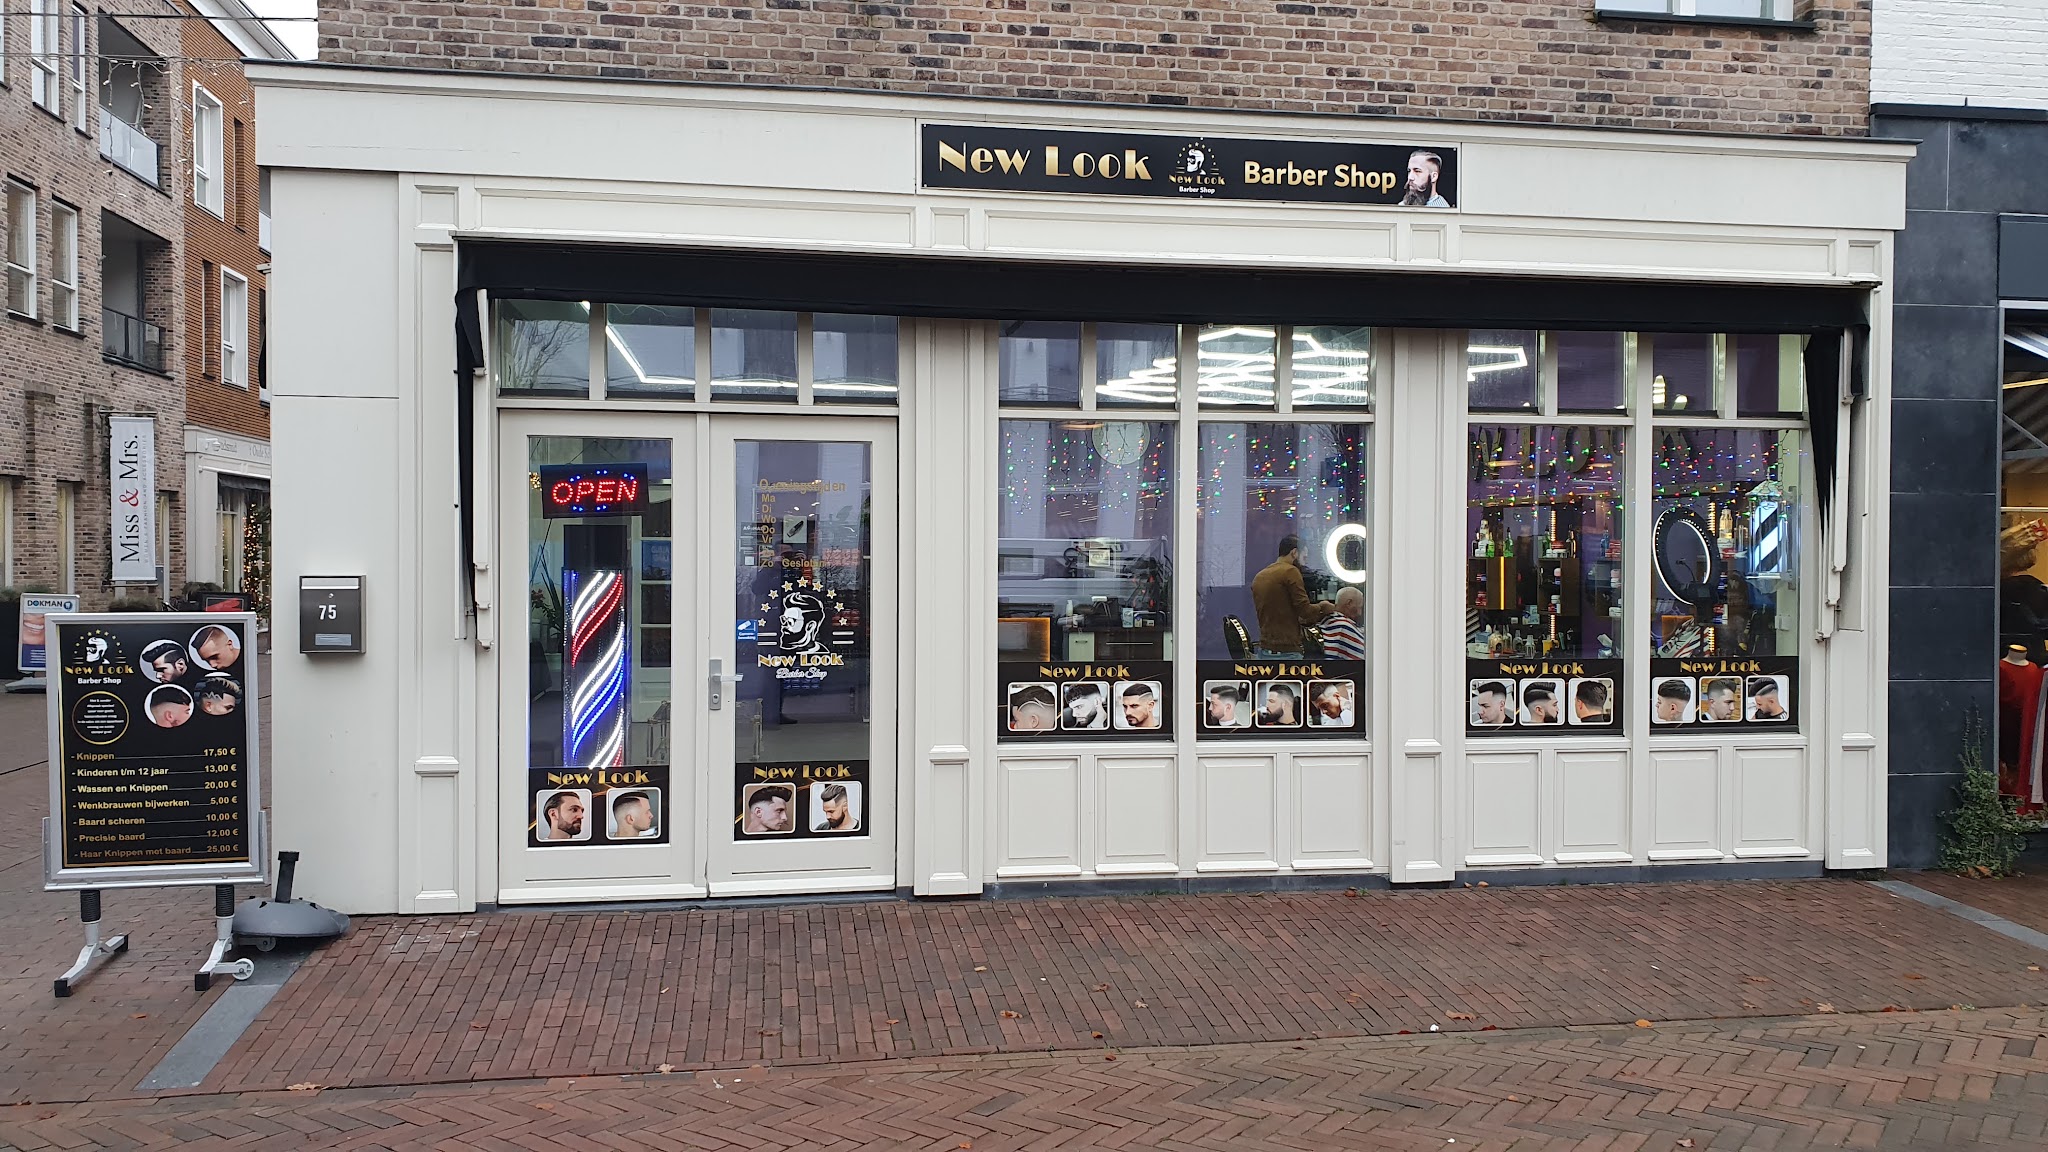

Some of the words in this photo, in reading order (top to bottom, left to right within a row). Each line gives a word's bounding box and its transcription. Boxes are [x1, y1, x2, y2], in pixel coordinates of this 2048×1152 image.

[939, 139, 1031, 175] New
[1045, 145, 1153, 180] Look
[1168, 174, 1194, 184] New
[1196, 175, 1226, 185] Look
[1244, 160, 1329, 186] Barber
[1333, 163, 1397, 194] Shop
[1178, 185, 1200, 193] Barber
[1200, 186, 1216, 195] Shop
[118, 435, 139, 480] Mrs.
[119, 488, 139, 507] &
[552, 480, 638, 504] OPEN
[761, 493, 776, 503] Ma
[762, 504, 772, 513] Di
[762, 514, 777, 524] Wo
[762, 525, 775, 534] Do
[119, 514, 140, 562] Miss
[762, 534, 773, 544] Vr
[318, 604, 337, 620] 75
[757, 653, 797, 668] New
[800, 652, 844, 667] Look
[1680, 660, 1716, 673] New
[1720, 659, 1761, 673] Look
[64, 665, 94, 675] New
[98, 664, 134, 675] Look
[1039, 665, 1080, 678] New
[1085, 664, 1131, 678] Look
[1234, 663, 1274, 676] New
[1279, 663, 1324, 676] Look
[1499, 662, 1537, 675] New
[1541, 662, 1585, 675] Look
[102, 677, 122, 685] Shop
[76, 752, 115, 762] Knippen
[203, 748, 228, 758] 17,50
[229, 747, 237, 756] €
[77, 768, 119, 777] Kinderen
[120, 767, 136, 776] t/m
[138, 767, 149, 776] 12
[150, 767, 169, 778] jaar
[204, 764, 229, 774] 13,00
[230, 763, 237, 772] €
[753, 765, 797, 780] New
[802, 764, 852, 778] Look
[547, 771, 593, 786] New
[598, 770, 650, 784] Look
[77, 785, 114, 793] Wassen
[129, 784, 169, 794] Knippen
[204, 781, 229, 790] 20,00
[230, 780, 237, 788] €
[78, 801, 143, 810] Wenkbrauwen
[145, 800, 190, 809] bijwerken
[210, 797, 230, 806] 5,00
[231, 796, 238, 804] €
[78, 818, 106, 826] Baard
[108, 817, 146, 826] scheren
[205, 813, 230, 822] 10,00
[232, 812, 238, 820] €
[79, 834, 117, 842] Precisie
[119, 833, 146, 841] baard
[206, 829, 231, 838] 12,00
[232, 828, 239, 836] €
[80, 851, 102, 859] Haar
[104, 849, 144, 859] Knippen
[165, 847, 192, 855] baard
[206, 845, 231, 854] 25,00
[232, 844, 239, 852] €
